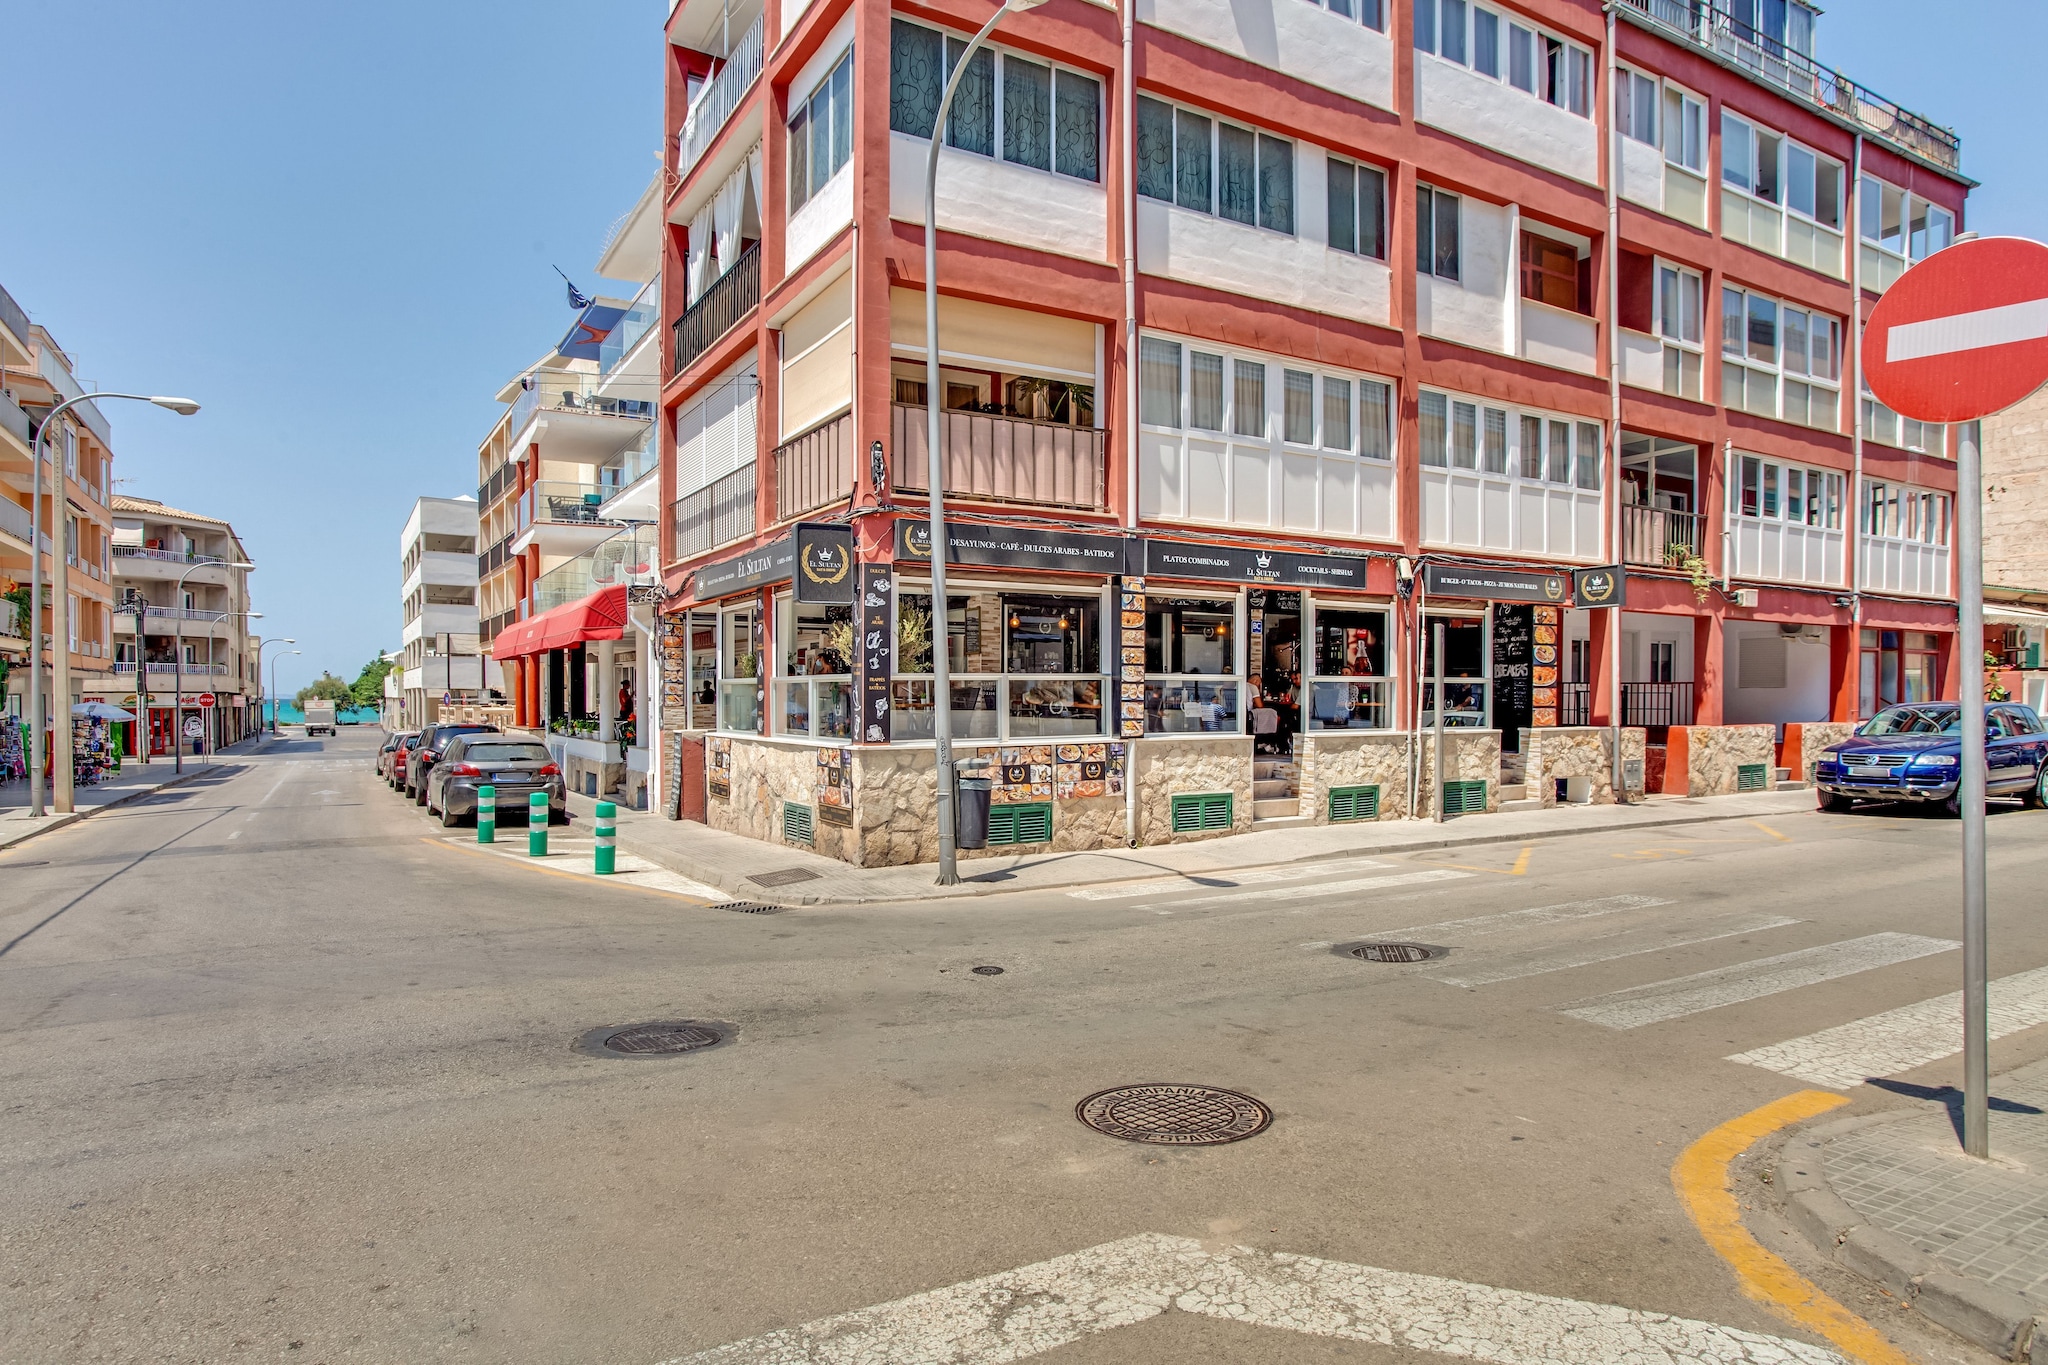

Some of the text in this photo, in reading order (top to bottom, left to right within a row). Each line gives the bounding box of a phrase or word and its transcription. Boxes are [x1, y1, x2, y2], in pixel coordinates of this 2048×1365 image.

[950, 538, 1114, 558] DESAYUNOS CAFÉ DULCES ARABES BATIDOS
[1163, 555, 1229, 566] PLATOS COMBINADOS
[738, 562, 746, 578] EL
[747, 556, 772, 576] SULTAN
[1256, 568, 1280, 577] SULTAN
[1298, 566, 1328, 574] COCKTAILS
